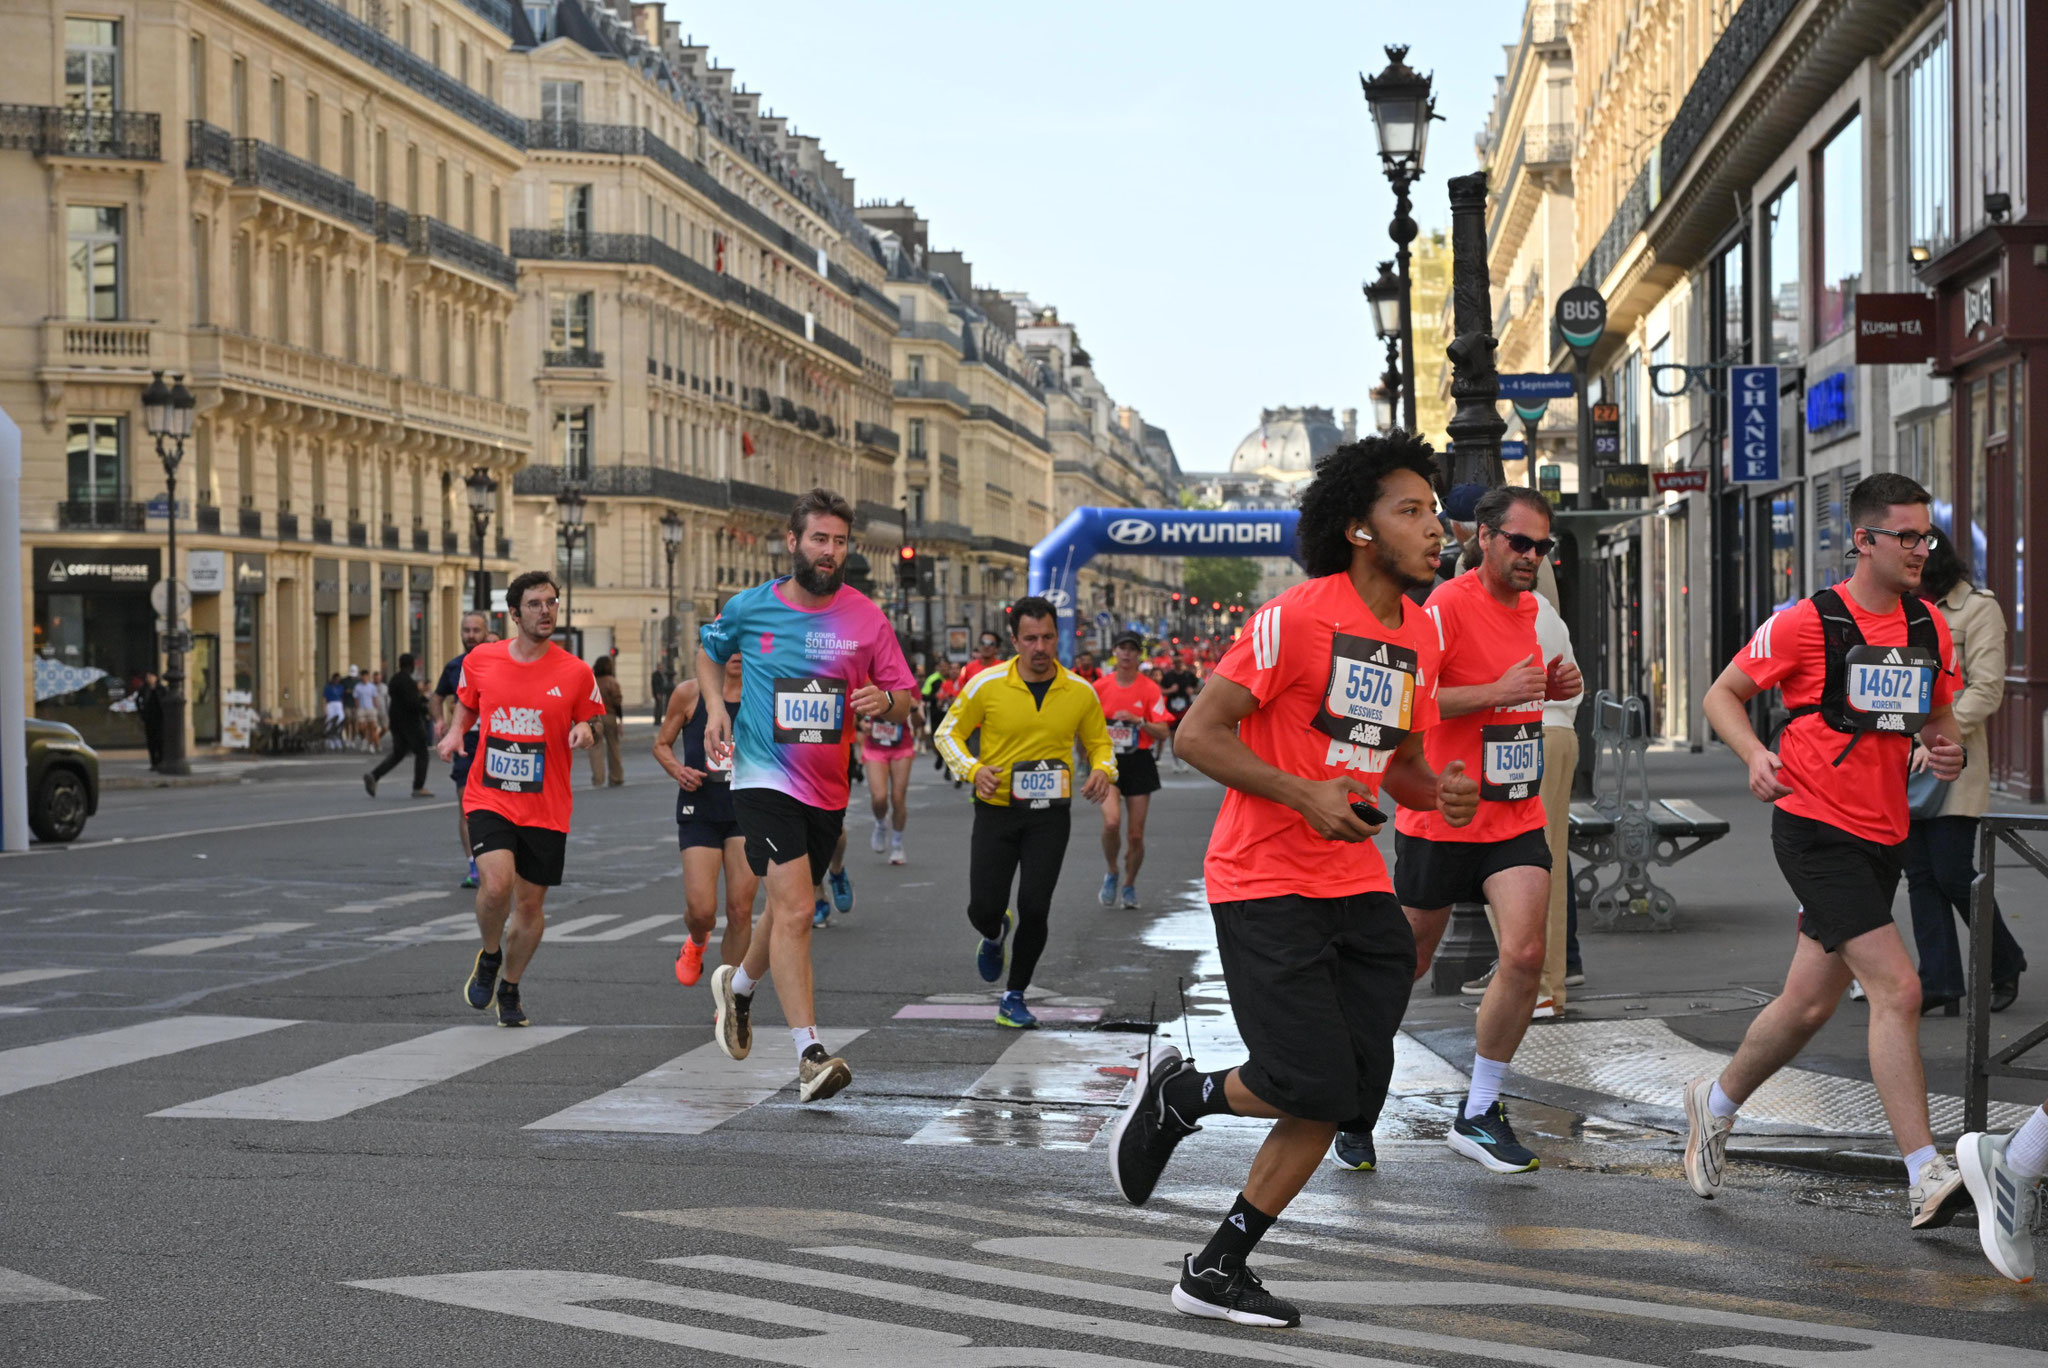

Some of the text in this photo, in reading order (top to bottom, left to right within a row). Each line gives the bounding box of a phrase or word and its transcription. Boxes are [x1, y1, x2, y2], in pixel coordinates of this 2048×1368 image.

[1563, 300, 1600, 320] BUS
[1861, 319, 1923, 336] KUSMI TEA
[1513, 380, 1519, 390] 4
[1521, 380, 1571, 391] Septembre
[1598, 406, 1615, 420] 27
[1743, 371, 1767, 477] CHANGE
[1596, 437, 1616, 453] 95
[1161, 522, 1282, 543] HYUNDAI
[67, 564, 149, 576] COFFEE HOUSE
[805, 637, 859, 650] SOLIDAIRE
[1346, 664, 1393, 707] 5576
[1859, 668, 1912, 698] 14672
[508, 706, 543, 720] 10K
[784, 700, 830, 723] 16146
[1348, 703, 1383, 721] NESSWESS
[1872, 700, 1902, 710] KORENTIN
[1876, 720, 1905, 730] PARIS
[1888, 713, 1904, 722] 10K
[490, 719, 544, 736] PARIS
[1363, 723, 1382, 736] 10K
[1349, 730, 1382, 746] PARIS
[490, 753, 529, 777] 16735
[1496, 743, 1533, 771] 13051
[1021, 773, 1055, 790] 6025
